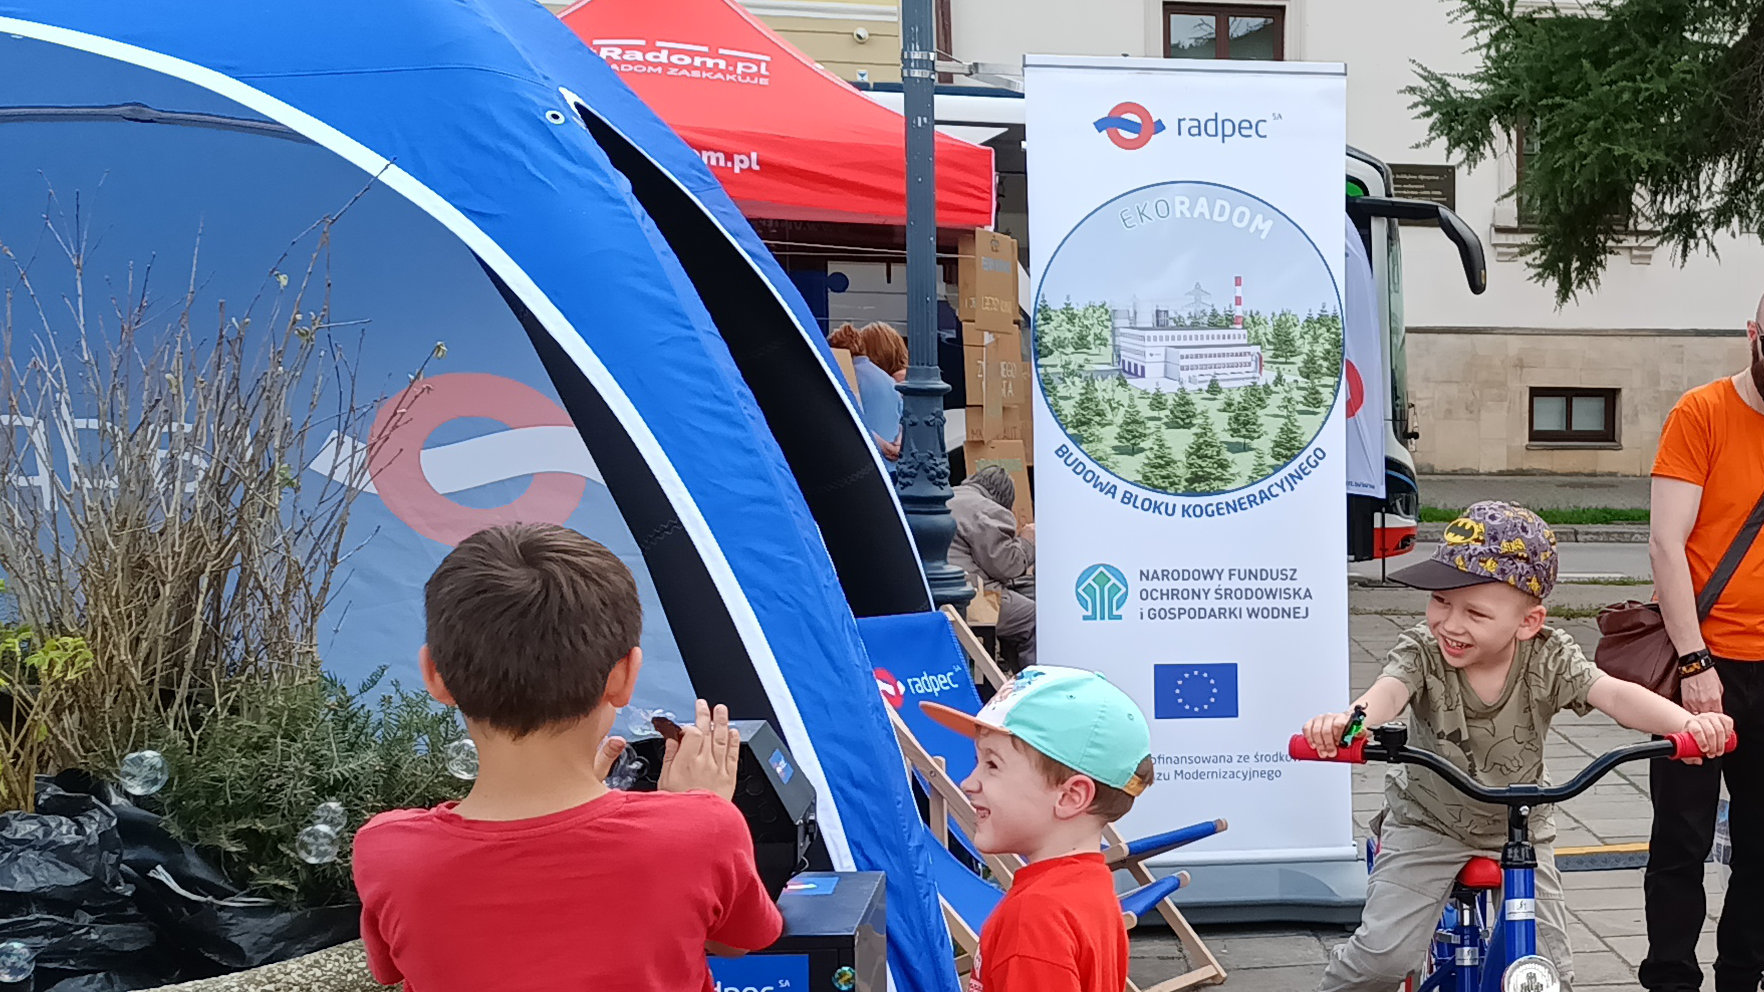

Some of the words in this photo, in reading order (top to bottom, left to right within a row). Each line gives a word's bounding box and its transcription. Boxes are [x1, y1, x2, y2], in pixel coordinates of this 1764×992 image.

[590, 46, 771, 76] Radom.pl
[610, 64, 662, 75] ADOM
[666, 67, 770, 86] ZASKAKUJE
[1177, 112, 1268, 144] radpec
[1119, 195, 1274, 240] EKORADOM
[1054, 443, 1118, 500] BUDOWA
[1119, 489, 1177, 517] BLOKU
[1181, 446, 1328, 519] KOGENERACYJNEGO
[1139, 568, 1225, 582] NARODOWY
[1228, 568, 1298, 581] FUNDUSZ
[1139, 588, 1211, 601] OCHRONY
[1214, 584, 1313, 601] ŚRODOWISKA
[1147, 607, 1243, 621] GOSPODARKI
[1246, 606, 1310, 620] WODNEJ
[906, 671, 959, 698] radpec
[1151, 753, 1233, 765] ofinansowana
[1237, 754, 1250, 764] ze
[1174, 767, 1282, 782] Modernizacyjnego
[777, 979, 791, 988] SA
